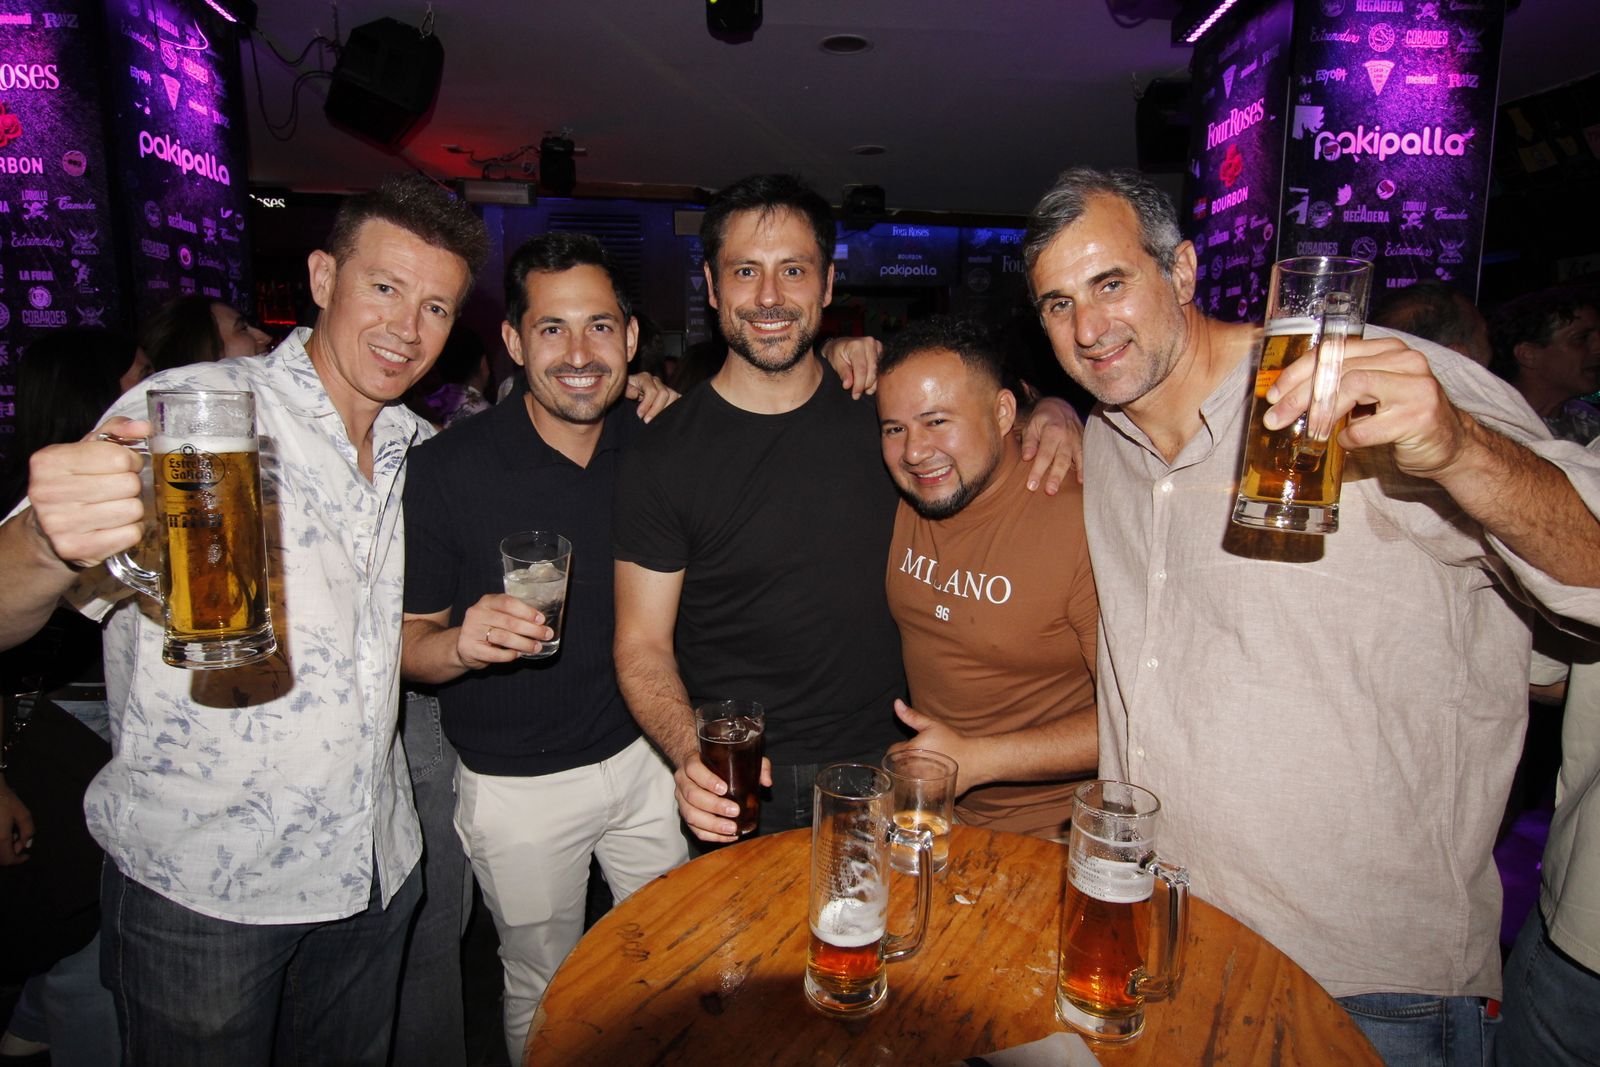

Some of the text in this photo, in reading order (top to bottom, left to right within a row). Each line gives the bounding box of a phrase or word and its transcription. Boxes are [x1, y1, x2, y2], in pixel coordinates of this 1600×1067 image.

[1206, 97, 1265, 151] Four Roses
[138, 130, 231, 186] pakipalla
[1211, 186, 1249, 216] BOURBON
[908, 226, 930, 237] Roses
[935, 604, 950, 621] 96
